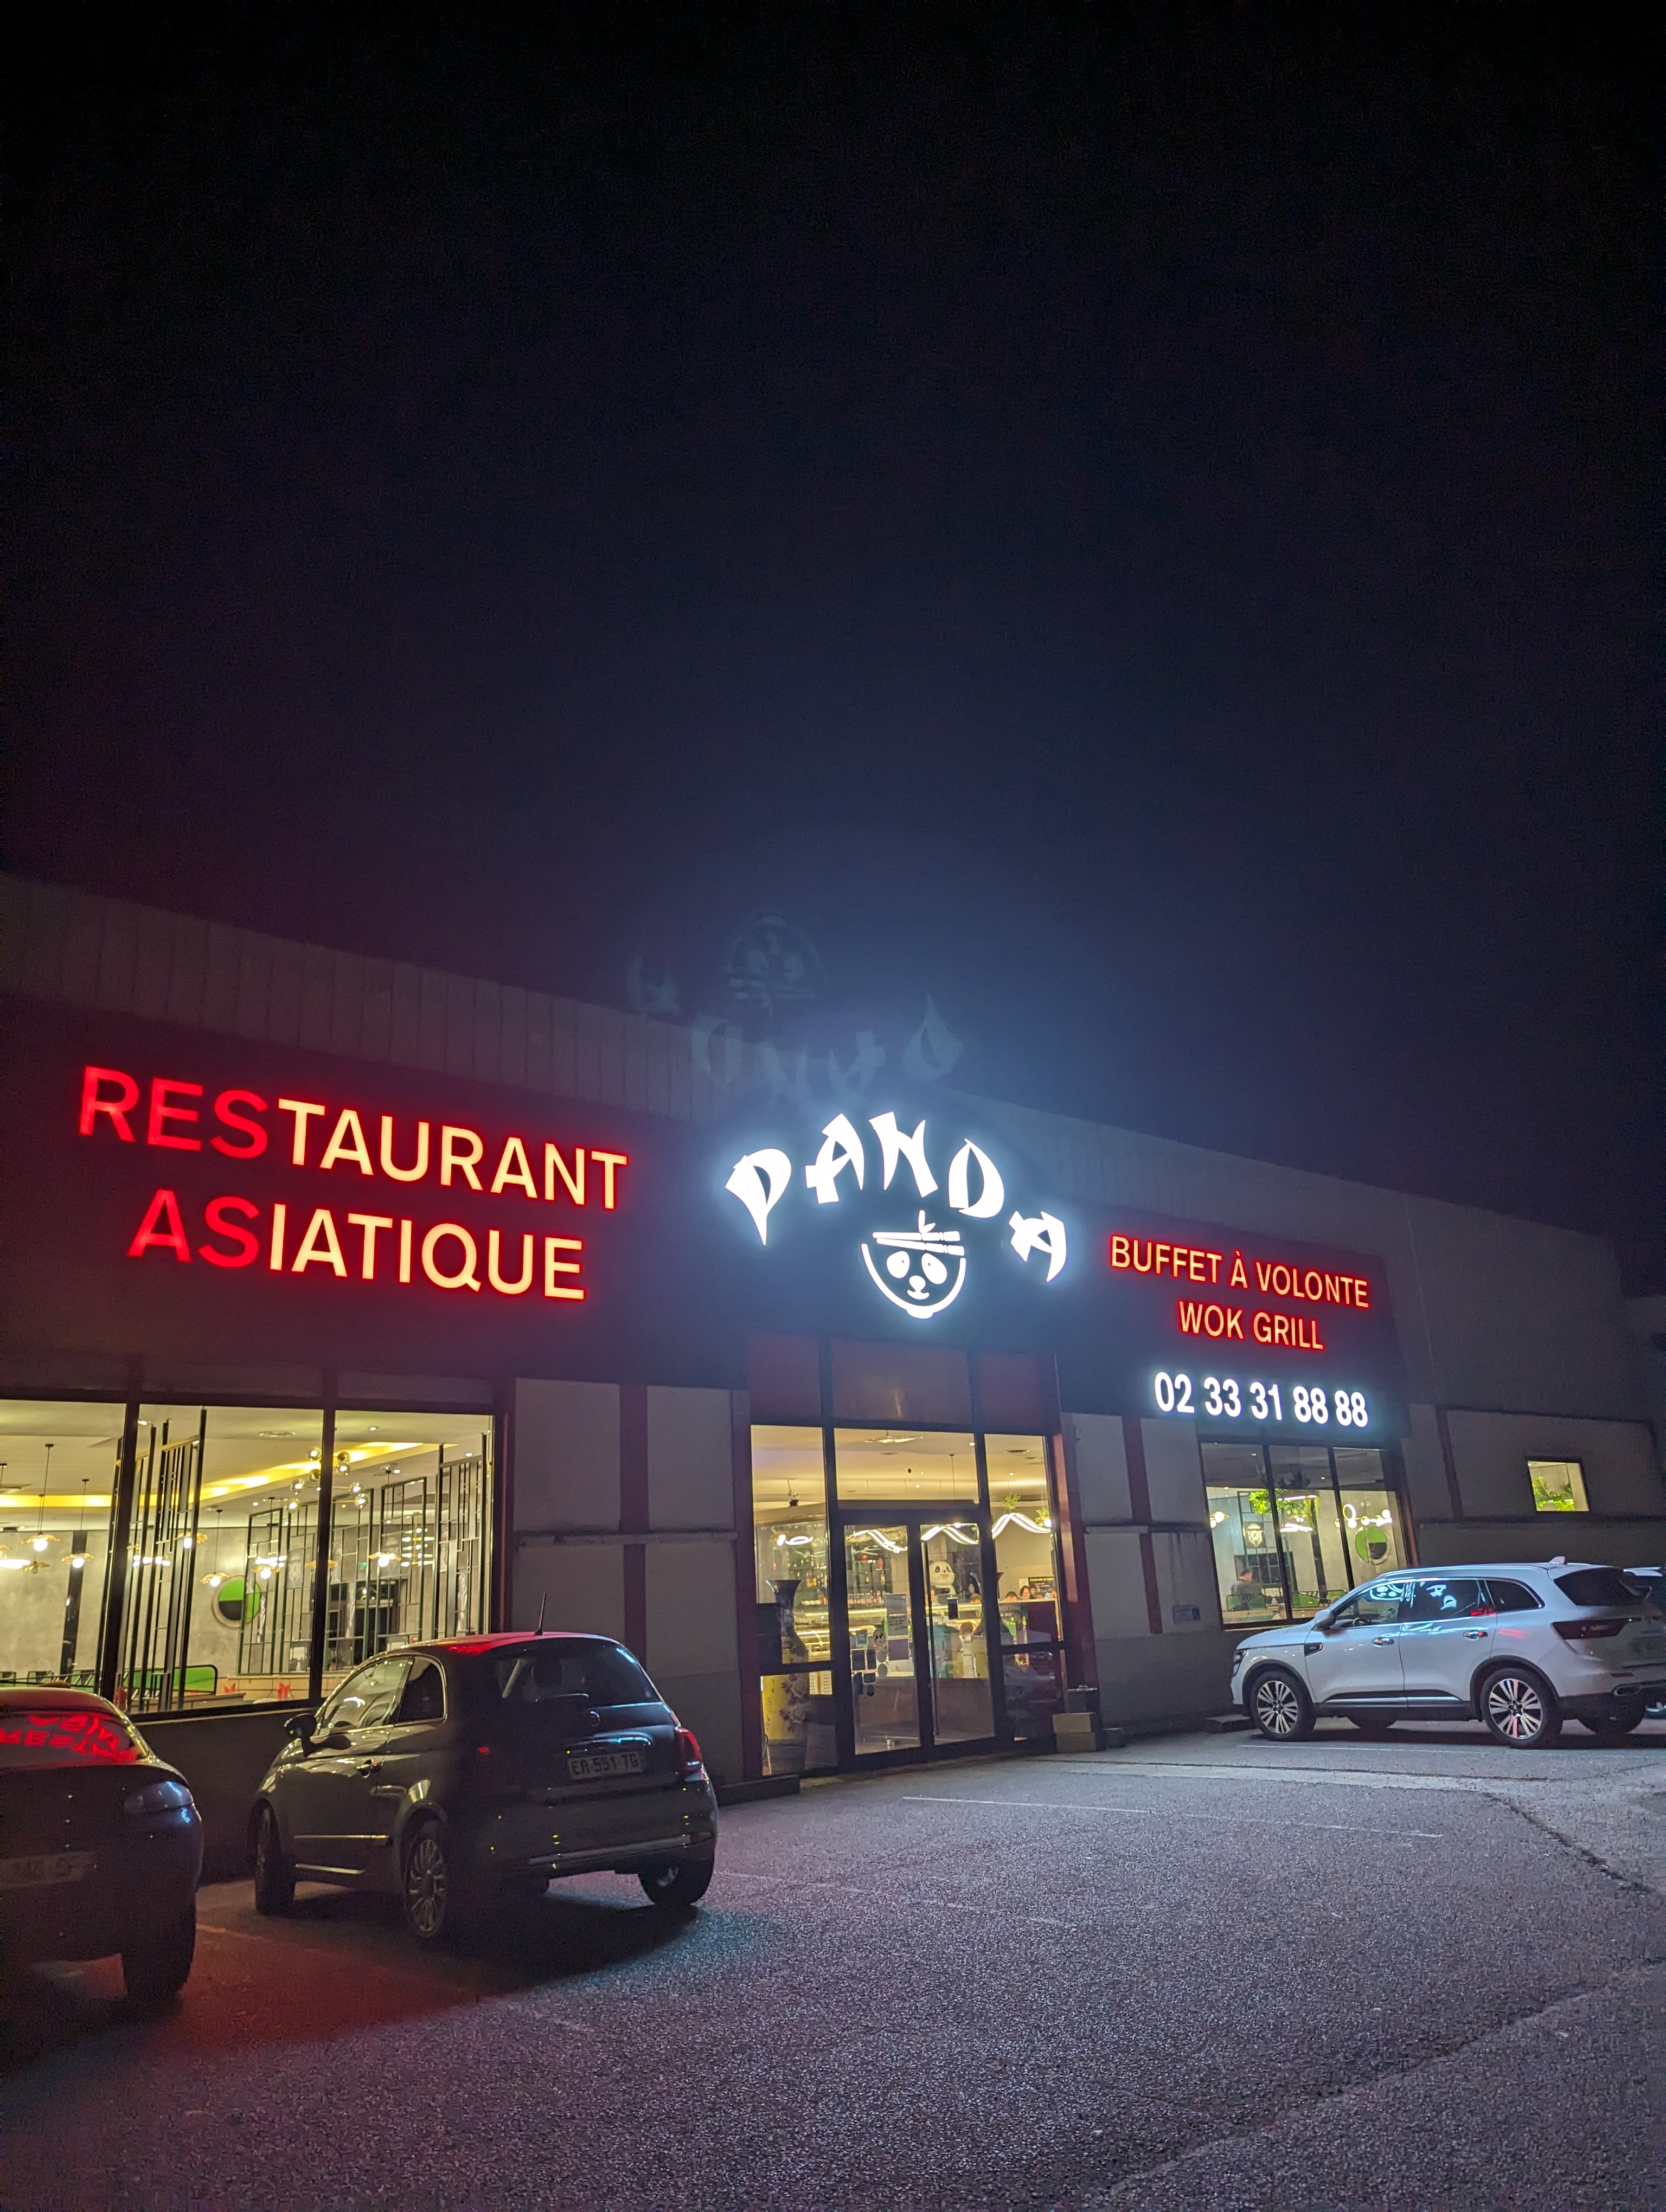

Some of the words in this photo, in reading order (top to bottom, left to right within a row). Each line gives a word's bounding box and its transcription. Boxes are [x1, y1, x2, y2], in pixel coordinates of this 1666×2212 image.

[79, 1066, 628, 1210] RESTAURANT
[725, 1111, 1067, 1282] PANDA
[127, 1189, 585, 1300] ASIATIQUE
[1111, 1235, 1222, 1283] BUFFET
[1230, 1250, 1248, 1289] À
[1255, 1262, 1369, 1308] VOLONTE
[1178, 1301, 1244, 1339] WOK
[1253, 1311, 1324, 1349] GRILL
[1155, 1372, 1195, 1413] 02
[1203, 1377, 1241, 1417] 33
[1250, 1381, 1282, 1420] 31
[1293, 1386, 1329, 1424] 88
[1334, 1390, 1368, 1427] 88
